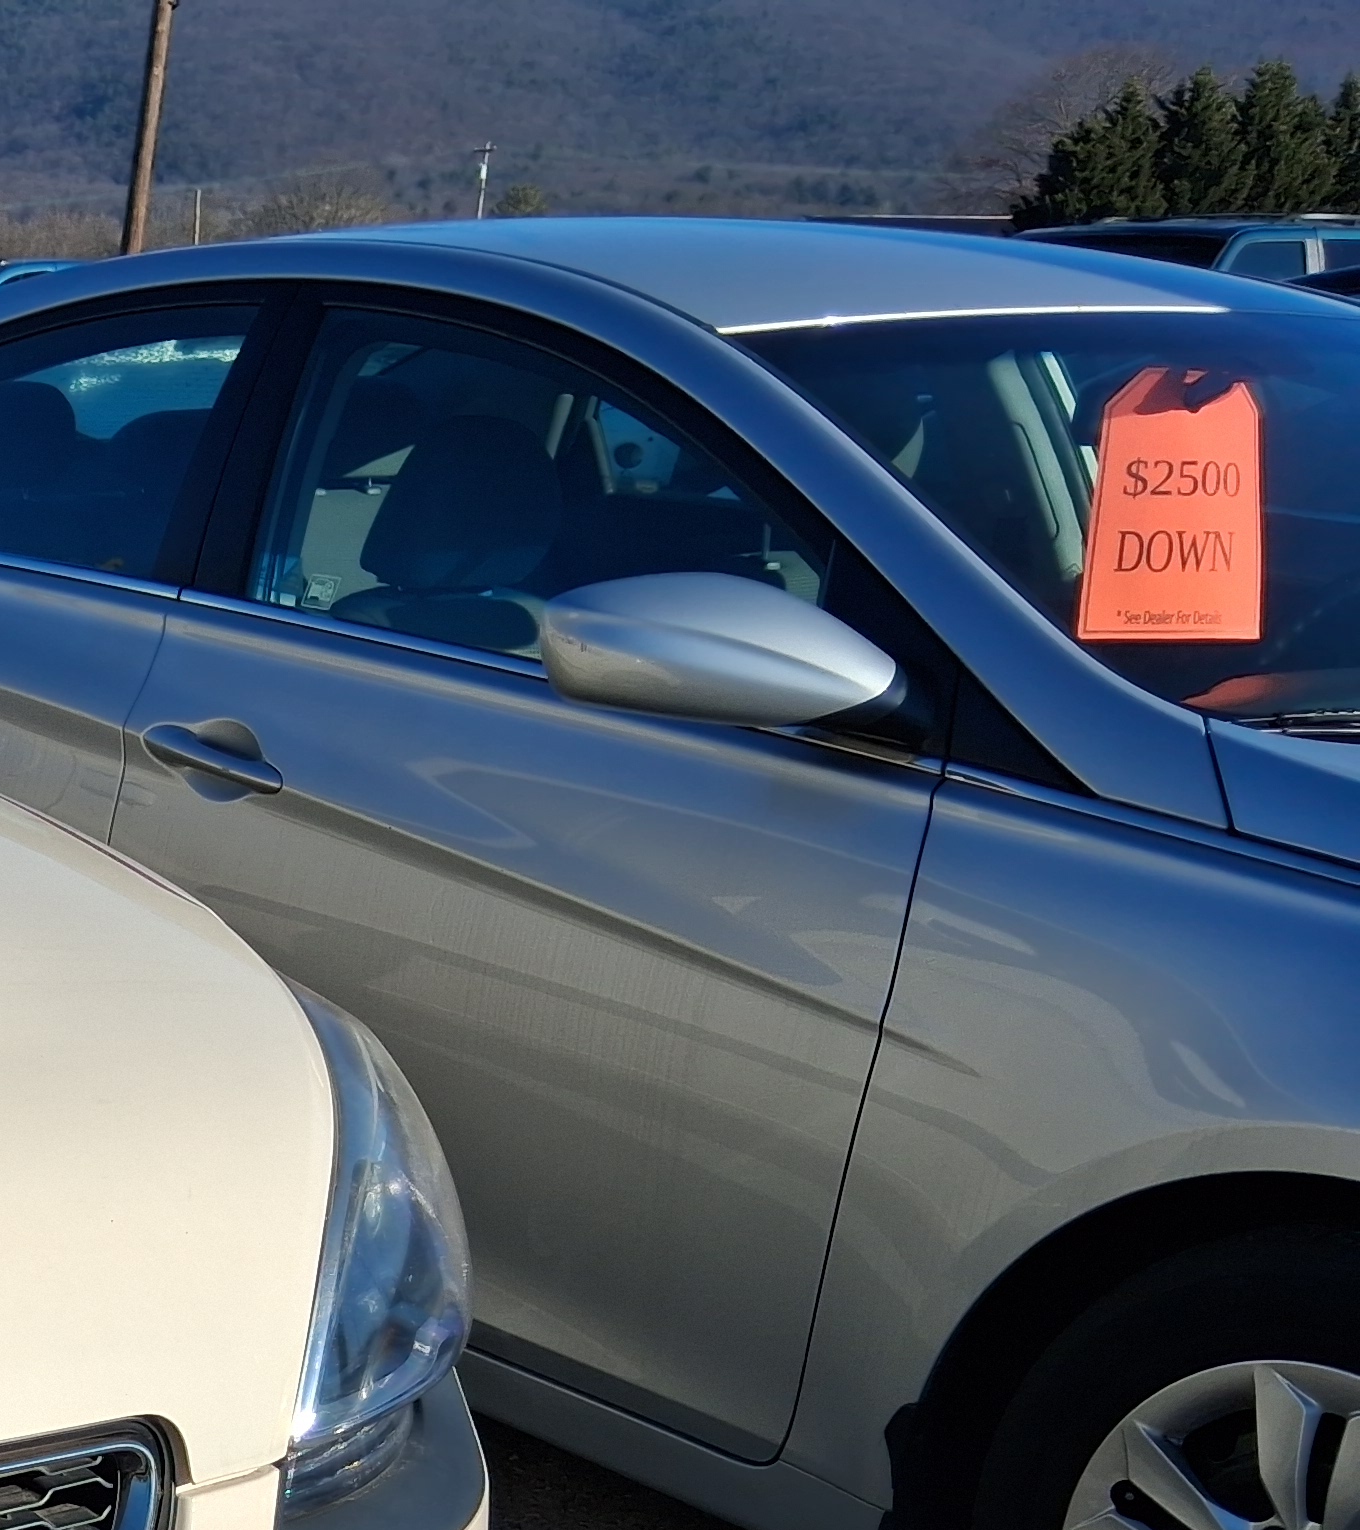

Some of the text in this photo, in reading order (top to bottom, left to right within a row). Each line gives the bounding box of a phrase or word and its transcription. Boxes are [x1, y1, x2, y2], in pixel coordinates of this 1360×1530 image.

[1122, 457, 1241, 499] $2500
[1113, 530, 1235, 573] DOWN
[1124, 610, 1141, 625] See
[1143, 609, 1175, 625] Dealer
[1176, 610, 1191, 624] For
